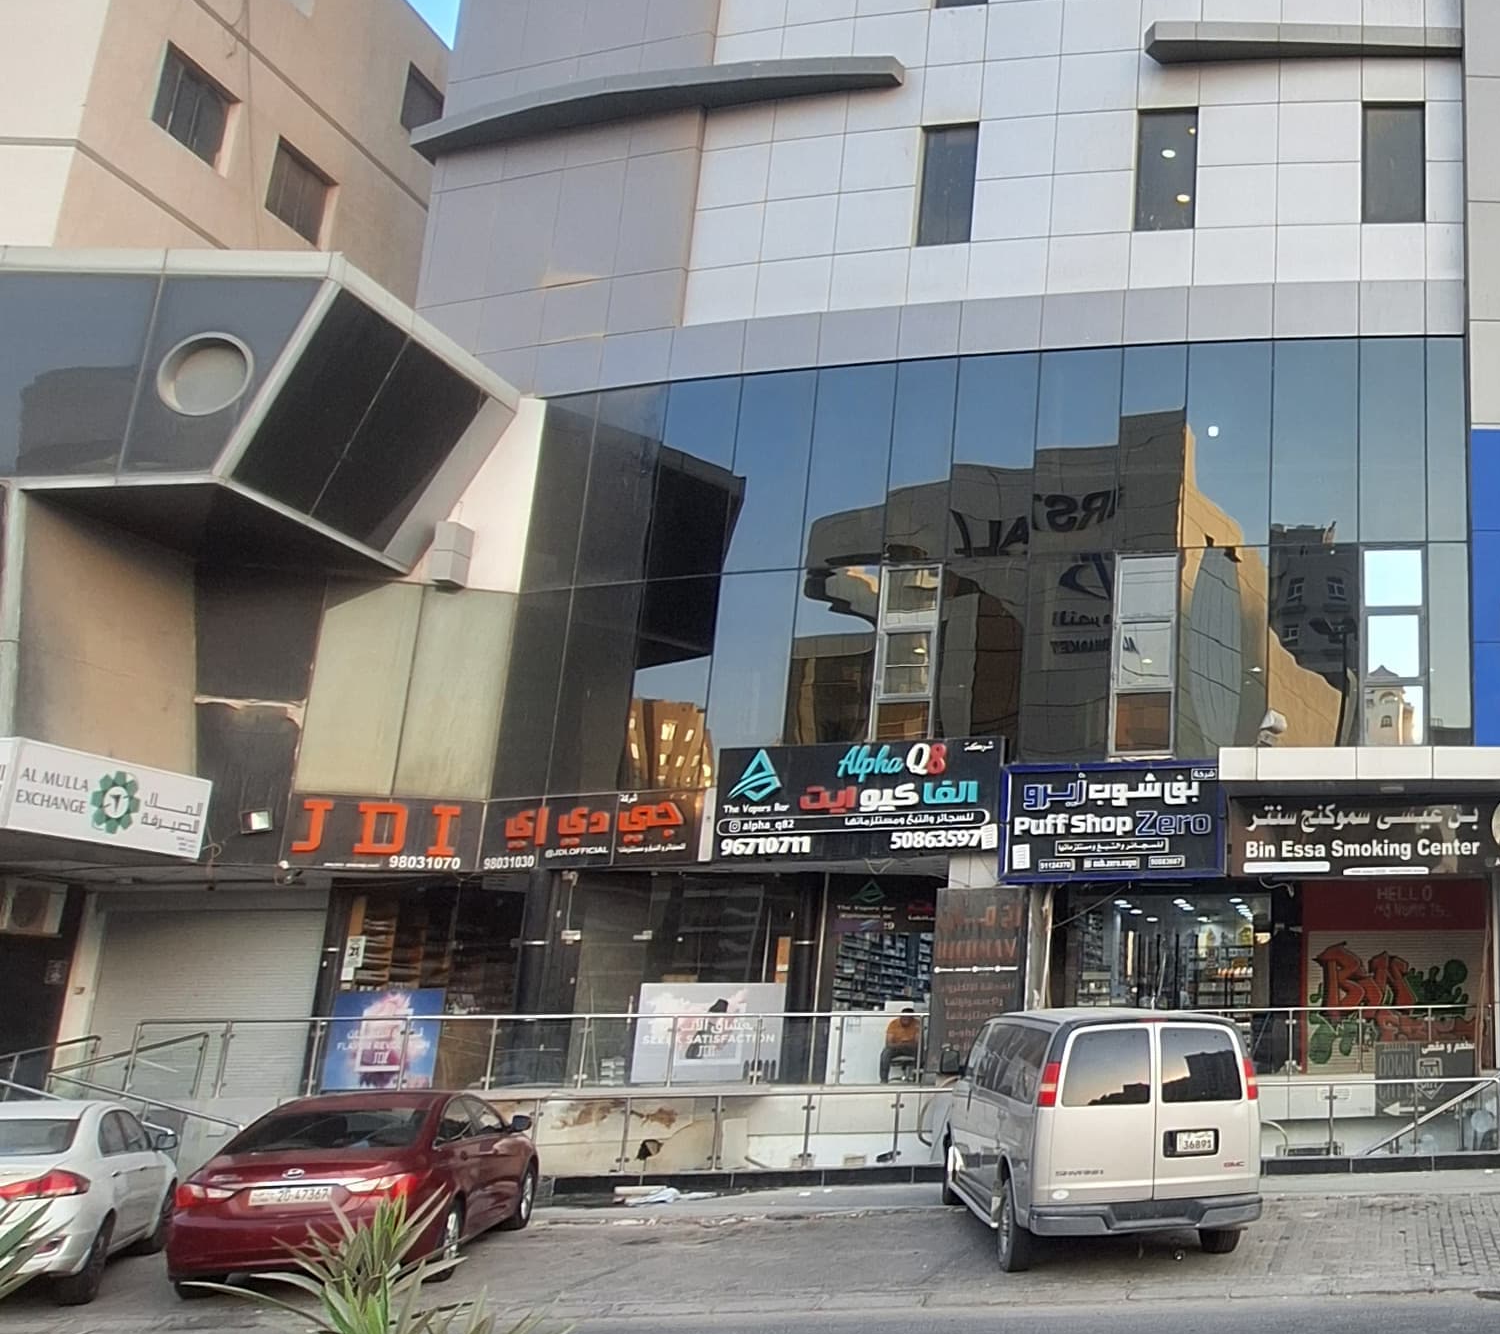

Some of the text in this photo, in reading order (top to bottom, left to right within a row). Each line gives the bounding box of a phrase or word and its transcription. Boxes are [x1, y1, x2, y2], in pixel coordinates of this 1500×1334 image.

[837, 742, 947, 783] Alpha Q8
[20, 767, 39, 782] AL
[42, 771, 89, 793] MULLA
[922, 780, 979, 805] الفا
[15, 789, 87, 814] EXCHANGE
[859, 782, 920, 812] كيو
[1014, 810, 1211, 836] Puff Shop Zero
[1447, 806, 1480, 829] بن
[720, 829, 983, 856] 96710711 50863597
[1245, 838, 1480, 860] Bin Essa Smoking Center
[389, 855, 461, 870] 98031070
[483, 855, 535, 870] 98031030
